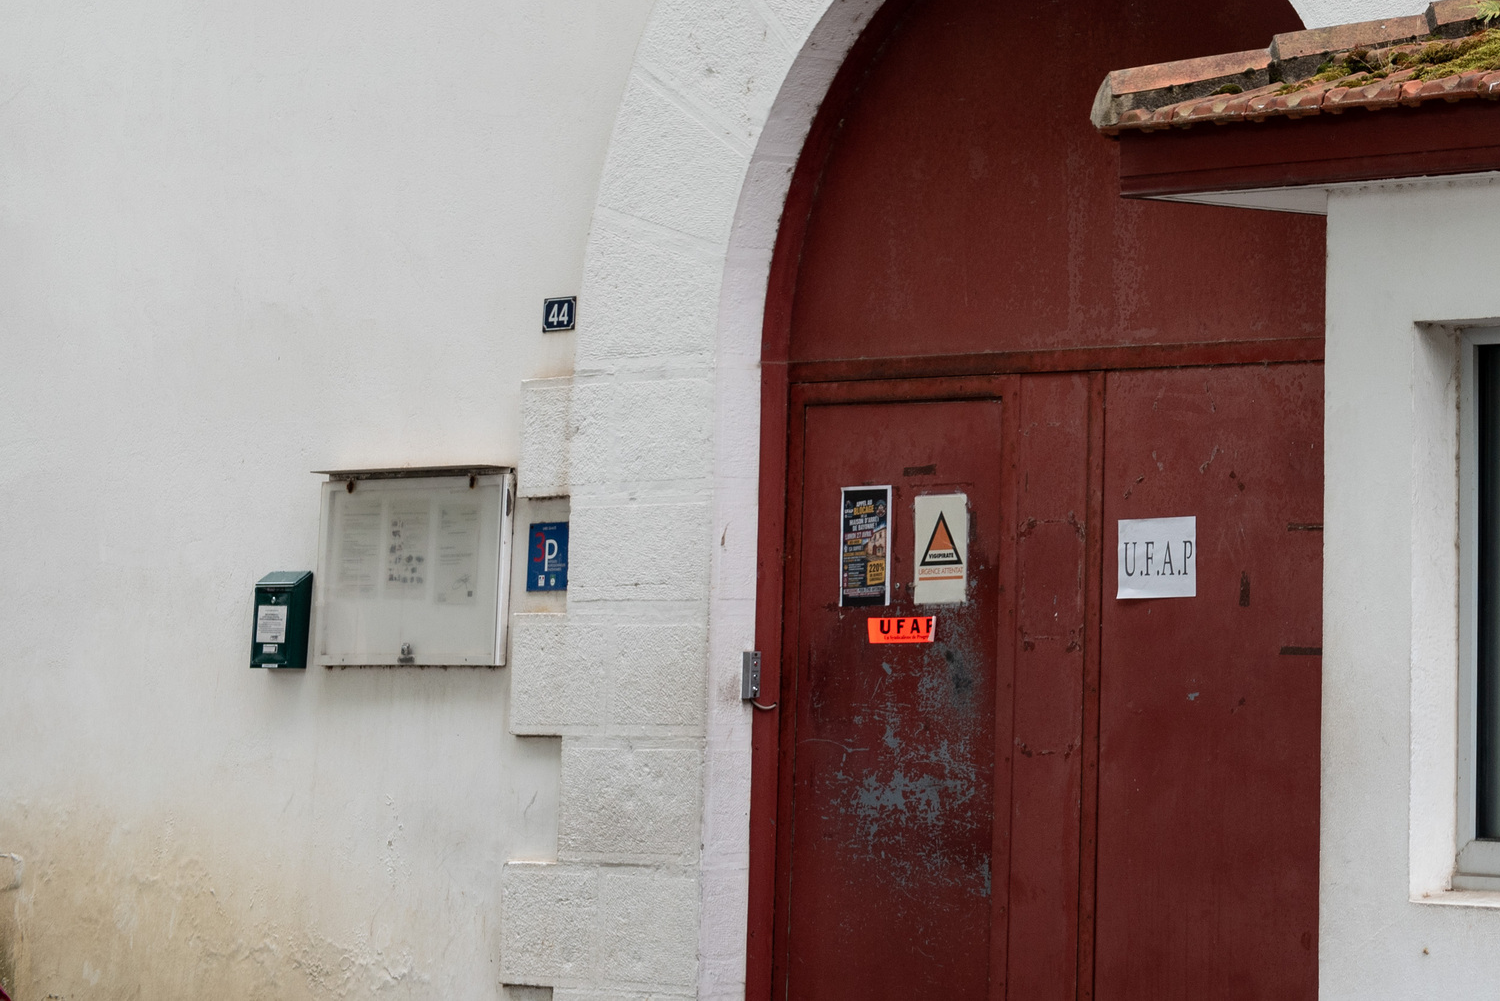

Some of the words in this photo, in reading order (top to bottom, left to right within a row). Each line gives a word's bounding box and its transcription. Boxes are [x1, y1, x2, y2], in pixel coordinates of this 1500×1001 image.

[548, 302, 569, 326] 44
[853, 504, 874, 516] BLOCAGE
[1124, 539, 1193, 578] U.F.A.P
[869, 562, 884, 573] 220%
[918, 567, 940, 576] URGENCE
[941, 566, 963, 575] ATTENTAT
